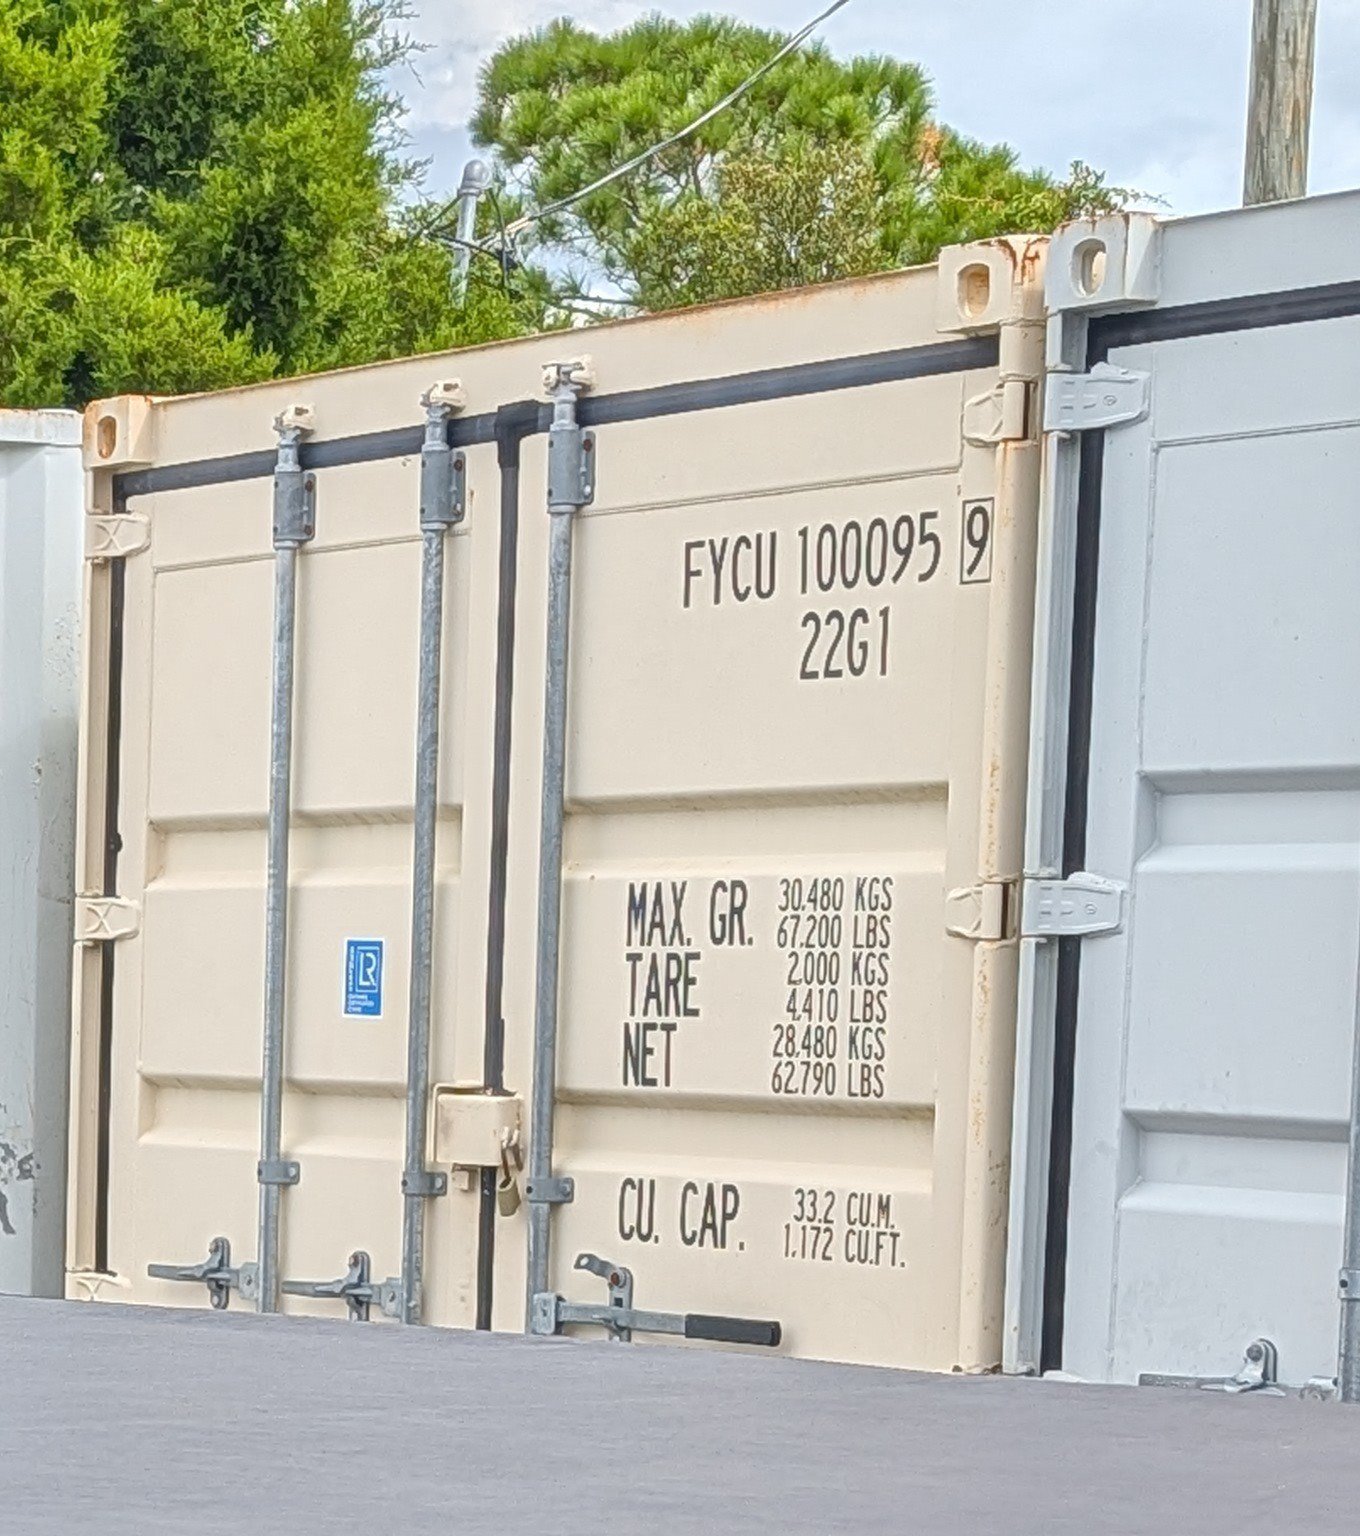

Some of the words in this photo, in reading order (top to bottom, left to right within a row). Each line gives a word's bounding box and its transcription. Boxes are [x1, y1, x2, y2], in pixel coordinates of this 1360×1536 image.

[683, 530, 777, 608] FYCU
[797, 510, 941, 595] 100095
[966, 505, 990, 577] 9
[799, 605, 890, 680] 22G1
[625, 880, 692, 947] MAX.
[709, 879, 754, 947] GR.
[854, 876, 894, 912] KGS
[852, 914, 891, 949] LBS
[625, 951, 701, 1018] TARE
[851, 951, 890, 986] KGS
[849, 988, 888, 1024] LBS
[622, 1021, 678, 1088] NET
[848, 1024, 887, 1061] KGS
[847, 1062, 885, 1098] LBS
[618, 1177, 660, 1245] CU.
[679, 1181, 746, 1251] CAP.
[793, 1187, 836, 1224] 33.2
[846, 1191, 896, 1229] CU.M.
[844, 1228, 906, 1268] CU.FT.
